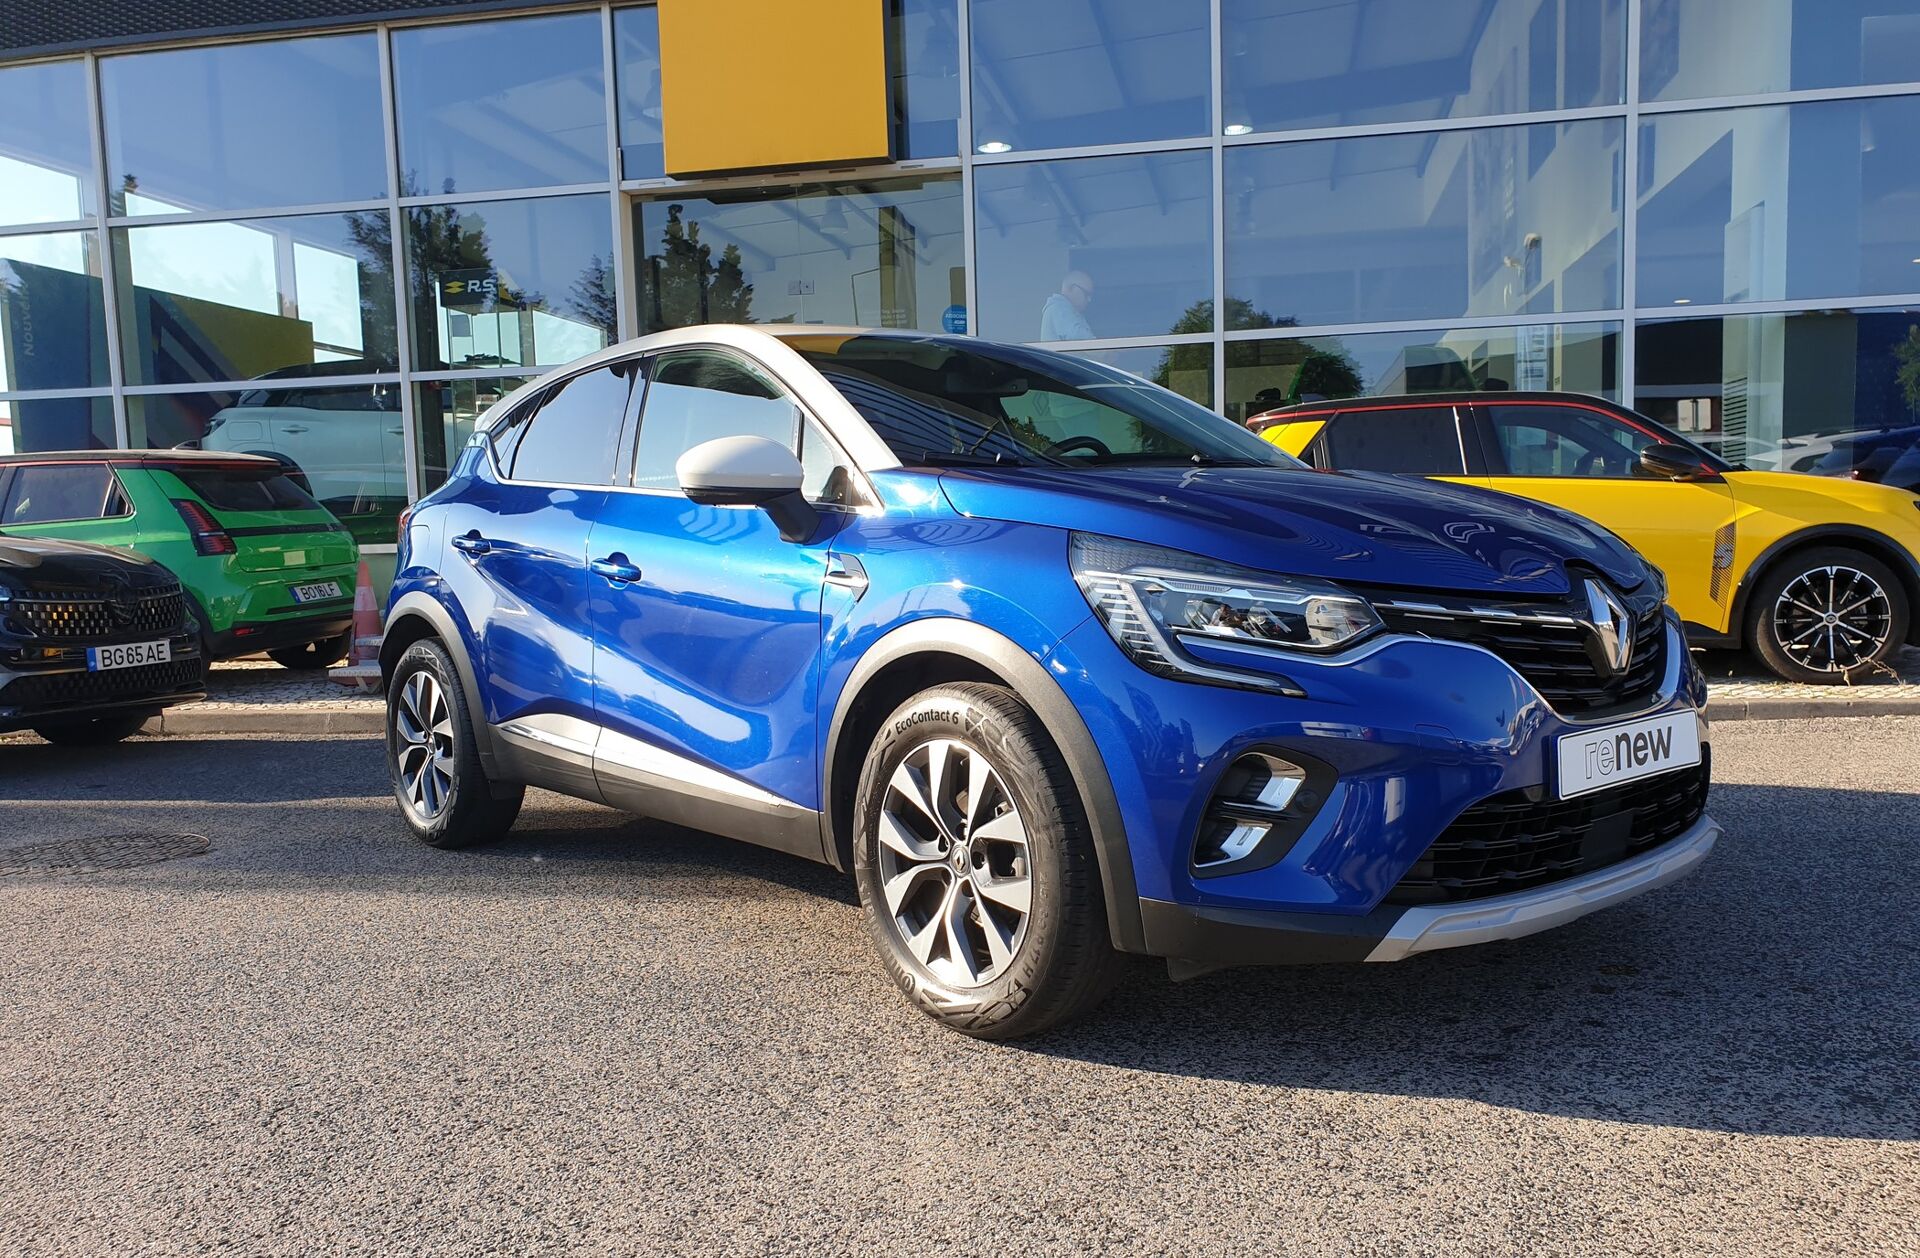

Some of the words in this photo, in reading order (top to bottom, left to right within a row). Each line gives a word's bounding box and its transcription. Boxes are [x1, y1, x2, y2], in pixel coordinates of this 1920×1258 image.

[895, 708, 950, 735] EcoContact
[952, 711, 960, 725] 6
[1584, 726, 1672, 780] renew
